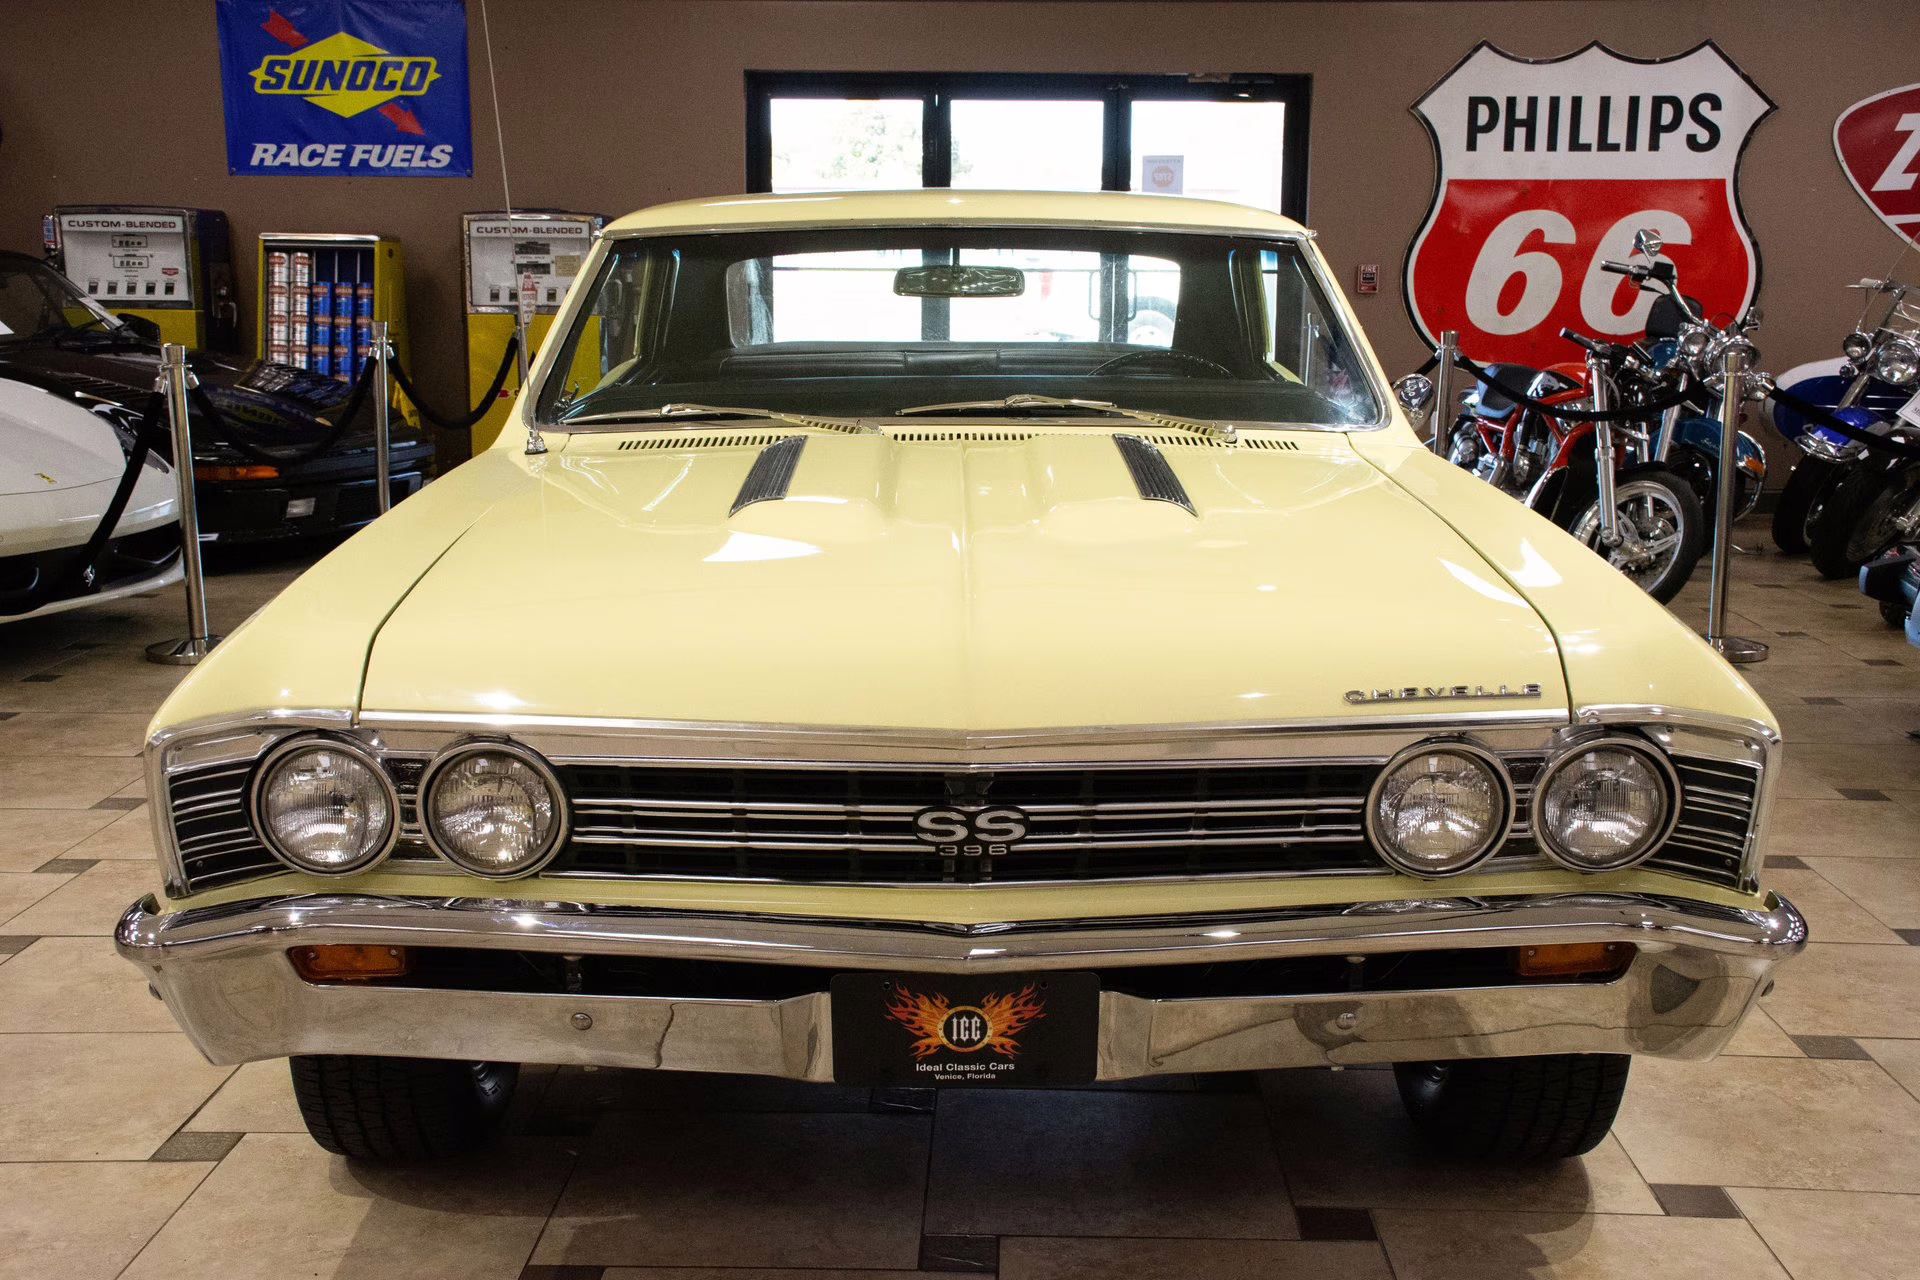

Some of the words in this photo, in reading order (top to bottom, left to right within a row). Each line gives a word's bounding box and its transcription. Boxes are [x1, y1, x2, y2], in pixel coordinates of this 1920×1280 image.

[259, 59, 432, 92] SUNOCO
[1465, 92, 1723, 153] PHILLIPS
[250, 143, 346, 167] RACE
[350, 144, 453, 168] FUELS
[68, 220, 177, 229] CUSTOM-BLENDED
[1464, 209, 1693, 336] 66
[1344, 683, 1541, 704] CHEVELLE
[916, 810, 1026, 842] SS
[939, 844, 1008, 856] 396
[916, 1063, 943, 1072] Ideal
[946, 1062, 986, 1072] Classic
[989, 1062, 1015, 1071] Cars
[934, 1073, 965, 1081] Venice,
[967, 1072, 996, 1080] Florida
